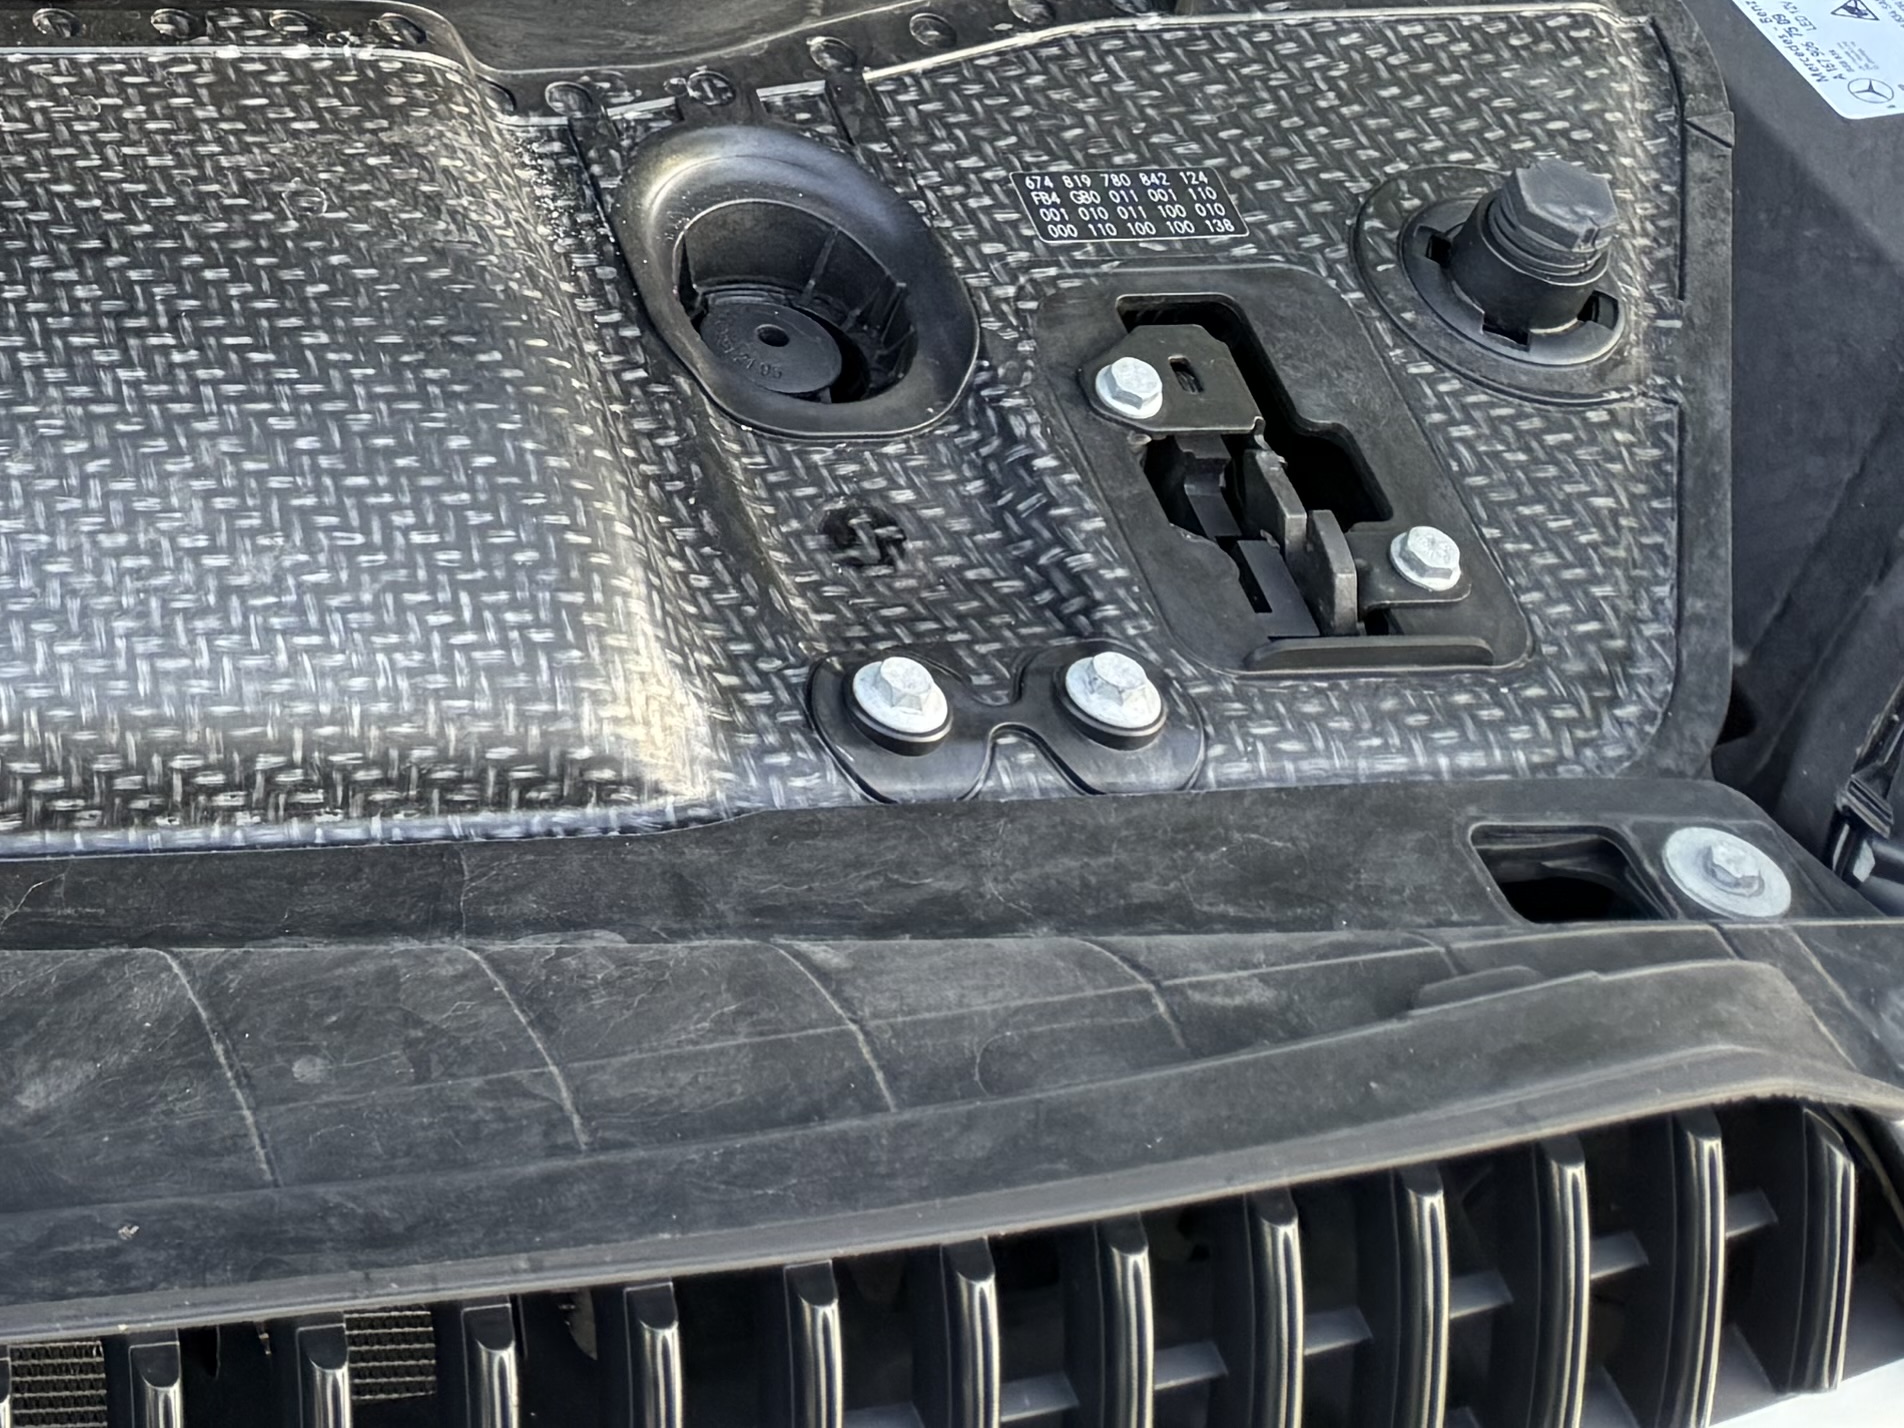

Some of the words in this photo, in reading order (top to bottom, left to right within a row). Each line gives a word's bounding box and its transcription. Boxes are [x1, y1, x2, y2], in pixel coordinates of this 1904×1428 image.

[1745, 1, 1773, 23] Benz
[1782, 1, 1798, 13] 12V
[1794, 16, 1817, 31] LED
[1778, 34, 1828, 82] Mercedes
[1816, 59, 1837, 72] 167
[1025, 175, 1053, 190] 674
[1062, 174, 1092, 189] 819
[1100, 173, 1131, 187] 780
[1139, 172, 1170, 187] 842
[1180, 171, 1209, 185] 124
[1109, 189, 1139, 204] 011
[1147, 188, 1178, 203] 001
[1188, 187, 1217, 201] 110
[1039, 207, 1069, 222] 001
[1078, 206, 1109, 221] 010
[1117, 206, 1147, 220] 011
[1157, 204, 1187, 219] 100
[1195, 203, 1226, 217] 010
[1048, 224, 1078, 238] 000
[1088, 223, 1117, 237] 110
[1127, 221, 1156, 236] 100
[1166, 219, 1195, 235] 100
[1205, 218, 1235, 233] 138
